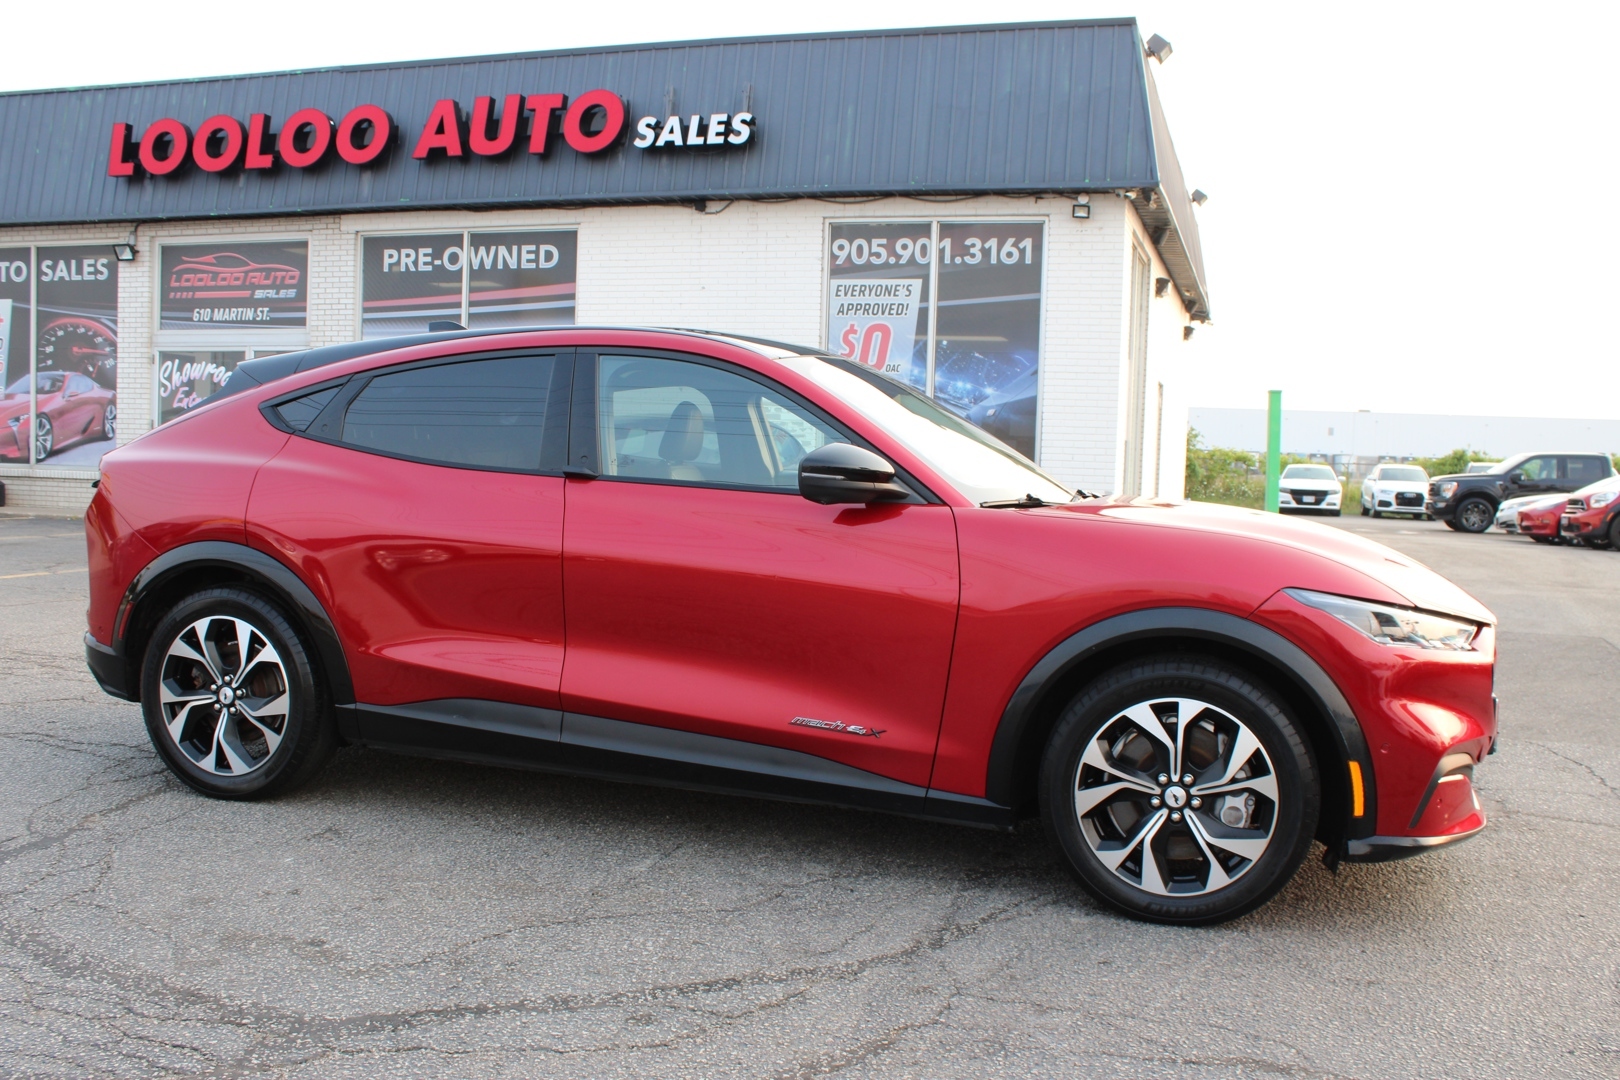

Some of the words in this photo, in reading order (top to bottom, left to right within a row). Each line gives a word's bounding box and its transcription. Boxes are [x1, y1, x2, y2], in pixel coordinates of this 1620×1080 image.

[109, 104, 391, 177] LOOLOO
[412, 89, 625, 160] AUTO
[633, 112, 754, 148] SALES
[383, 244, 559, 272] PRE-OWNED
[832, 237, 1032, 265] 905.901.3161
[41, 258, 109, 282] SALES
[170, 272, 244, 287] LOOLOO
[245, 271, 300, 286] AUTO
[253, 289, 297, 298] SALES
[835, 284, 912, 298] EVERYONE'S
[193, 308, 211, 321] 610
[213, 307, 255, 321] MARTIN
[255, 307, 270, 321] ST.
[836, 303, 909, 317] APPROVED!
[841, 322, 892, 371] $0
[885, 363, 901, 373] OAC
